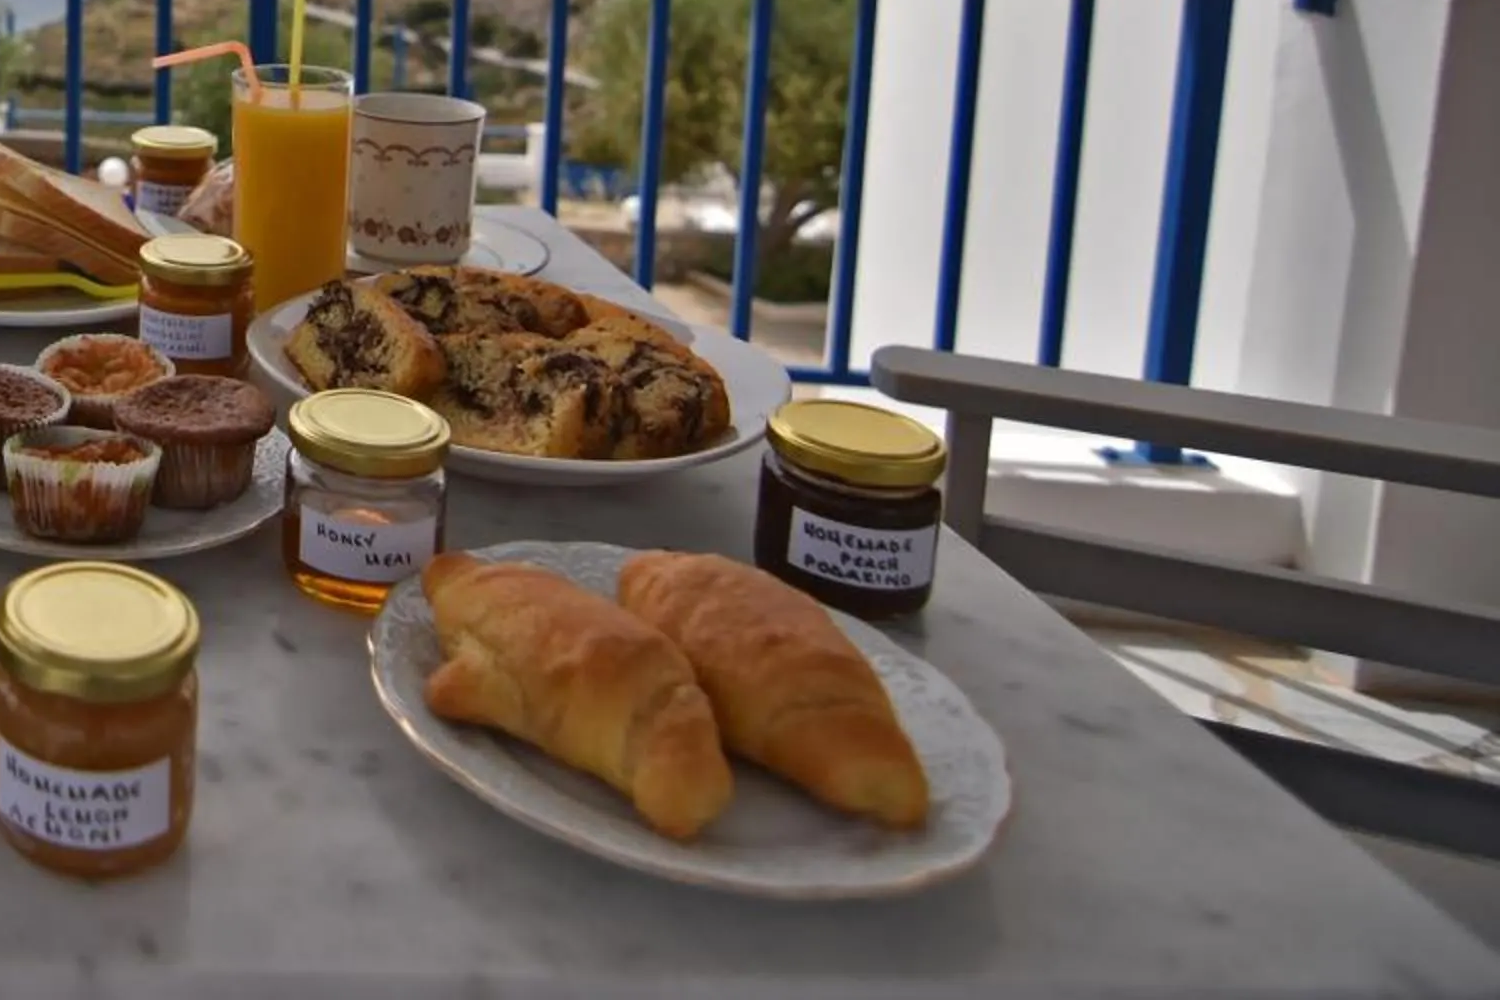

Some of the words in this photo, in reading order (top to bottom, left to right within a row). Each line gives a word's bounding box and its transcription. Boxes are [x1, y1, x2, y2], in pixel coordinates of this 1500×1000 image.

[317, 522, 376, 548] HONEY
[803, 521, 914, 554] HOMEMADE
[840, 551, 899, 571] PEACH
[6, 752, 141, 802] HOMEMADE
[45, 801, 129, 824] LEMON
